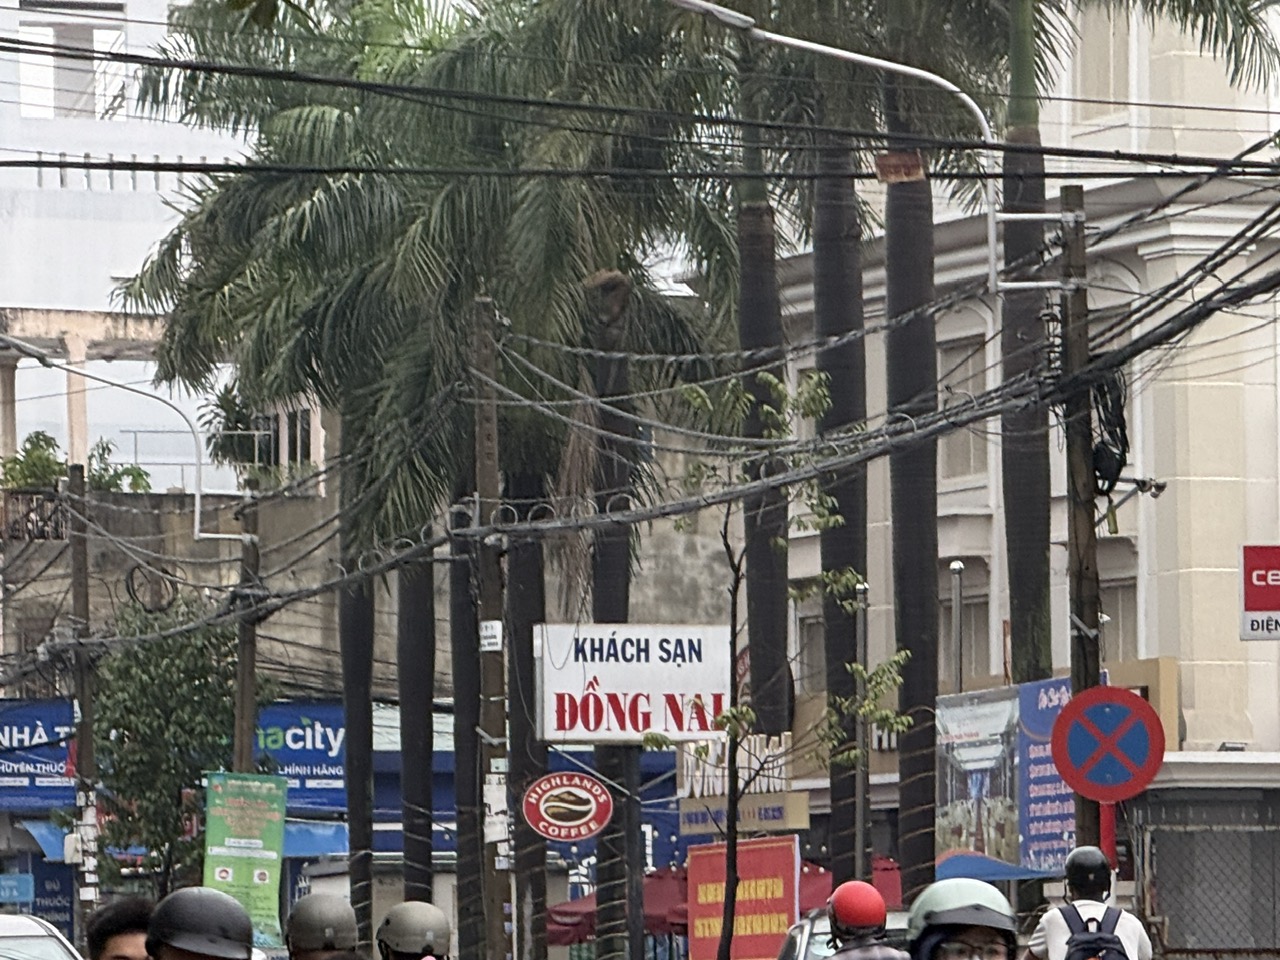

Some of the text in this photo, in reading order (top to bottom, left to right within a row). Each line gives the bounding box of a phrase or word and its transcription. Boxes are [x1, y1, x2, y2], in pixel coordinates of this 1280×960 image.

[574, 631, 703, 668] KHÁCH SẠN
[554, 675, 725, 733] ĐỒNG NAI
[0, 720, 49, 747] NHÀ
[527, 775, 608, 804] HIGHLANDS
[539, 820, 599, 838] COFFEE
